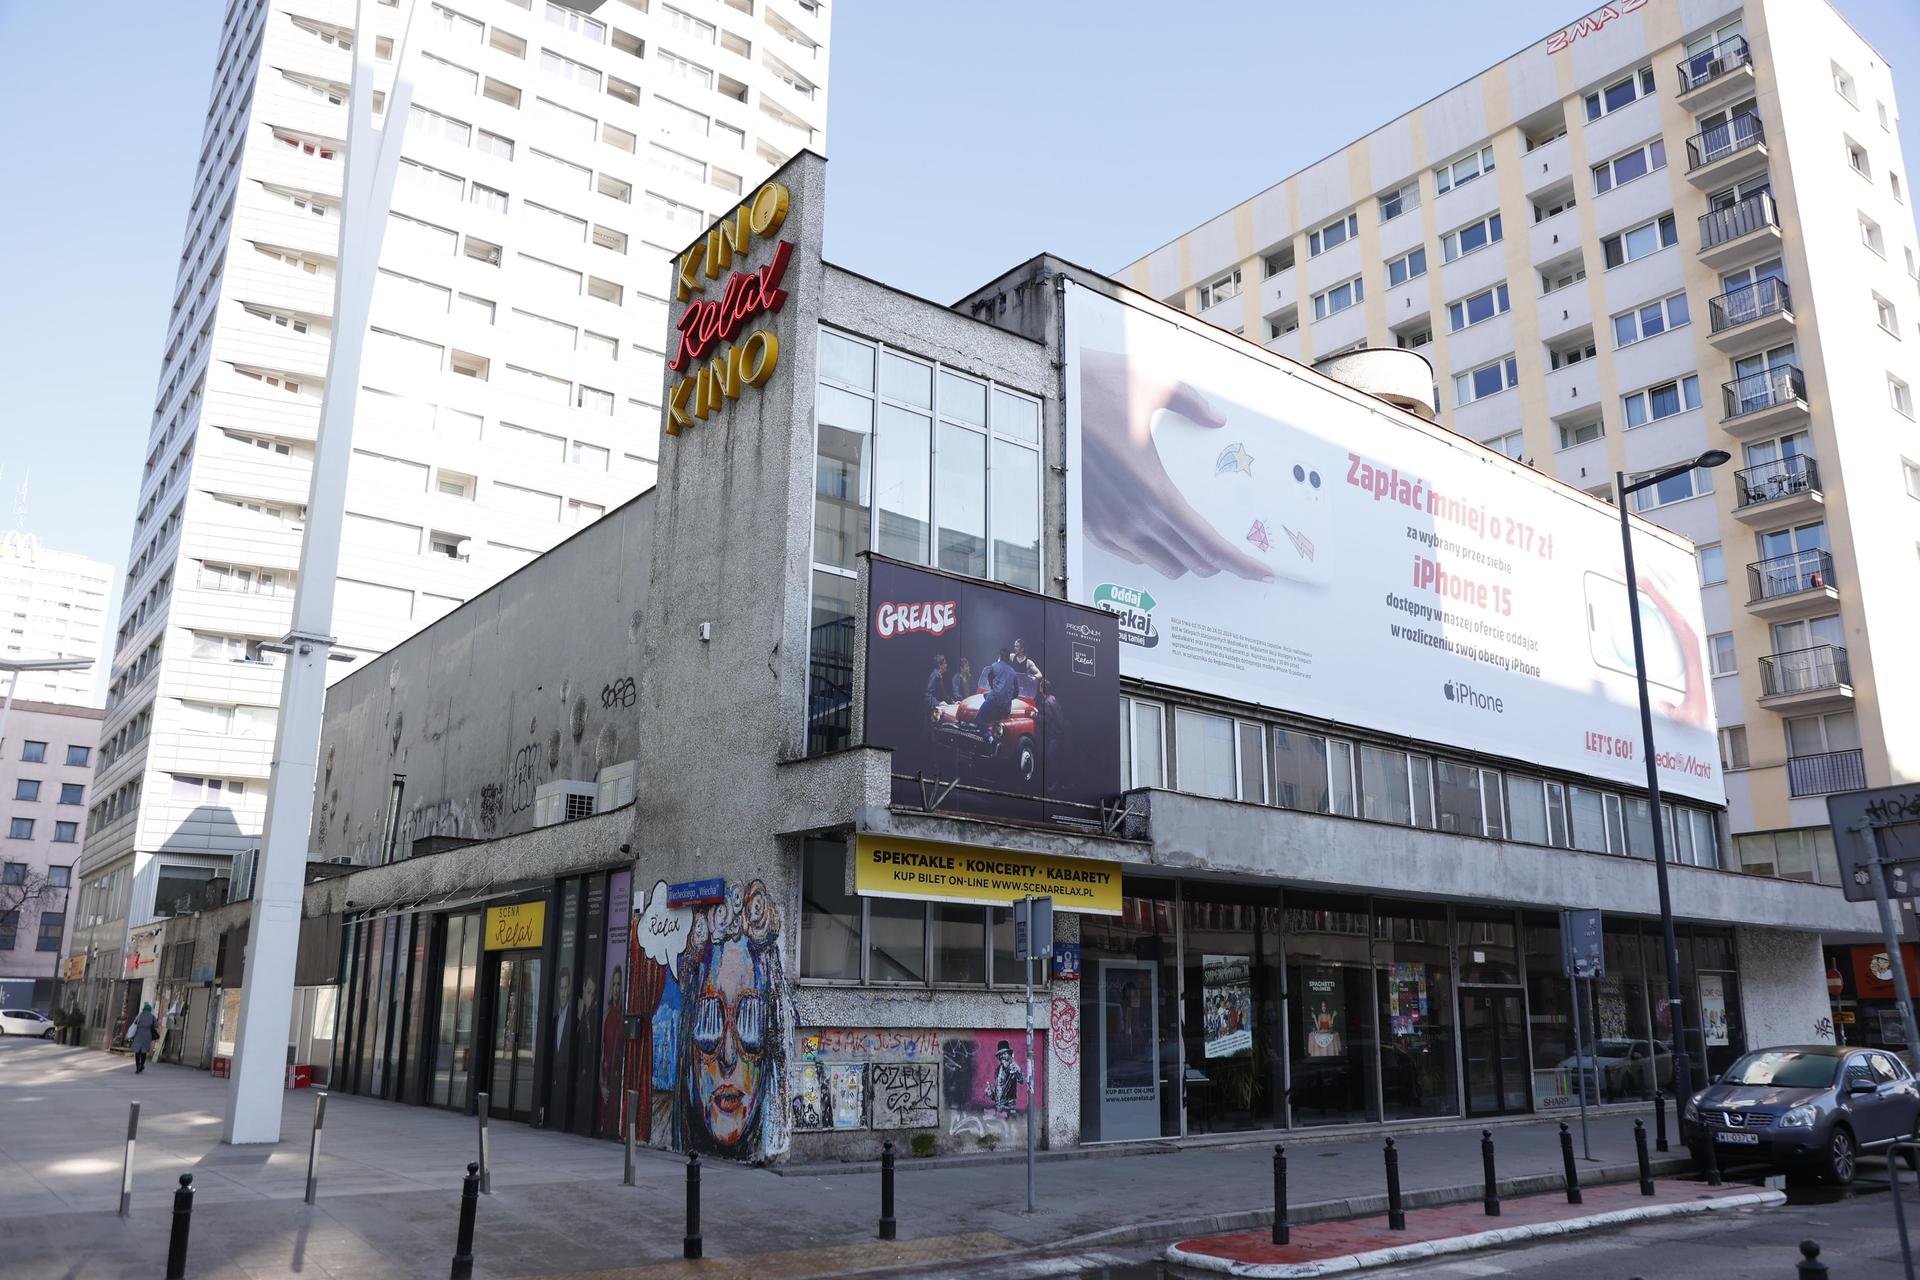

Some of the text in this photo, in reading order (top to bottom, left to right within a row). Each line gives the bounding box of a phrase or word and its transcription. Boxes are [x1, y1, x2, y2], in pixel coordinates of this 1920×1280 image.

[677, 182, 789, 303] KINO
[668, 239, 794, 373] Relax
[666, 329, 779, 436] KINO
[1346, 453, 1555, 561] Zapłać mniej o 217 zł
[1407, 526, 1512, 573] za wybrany przez siebie
[1110, 586, 1142, 609] Oddaj
[1413, 555, 1512, 617] iPhone 15
[877, 601, 957, 638] GREASE
[1386, 592, 1433, 622] dostępny
[1434, 608, 1443, 622] w
[1444, 612, 1473, 632] naszej
[1474, 620, 1505, 642] ofercie
[1390, 623, 1541, 678] w rozliczeniu swój obecny iPhone
[1455, 683, 1503, 714] iPhone
[1585, 731, 1633, 760] LET'S GO!
[873, 850, 1110, 884] SPEKTAKLE KONCERTY KABARETY
[894, 871, 1095, 897] KUP BILET ON-LINE WWW.SCENARELAX.PL
[499, 906, 520, 918] SCENA
[648, 916, 681, 937] Relax
[496, 917, 533, 947] Relax
